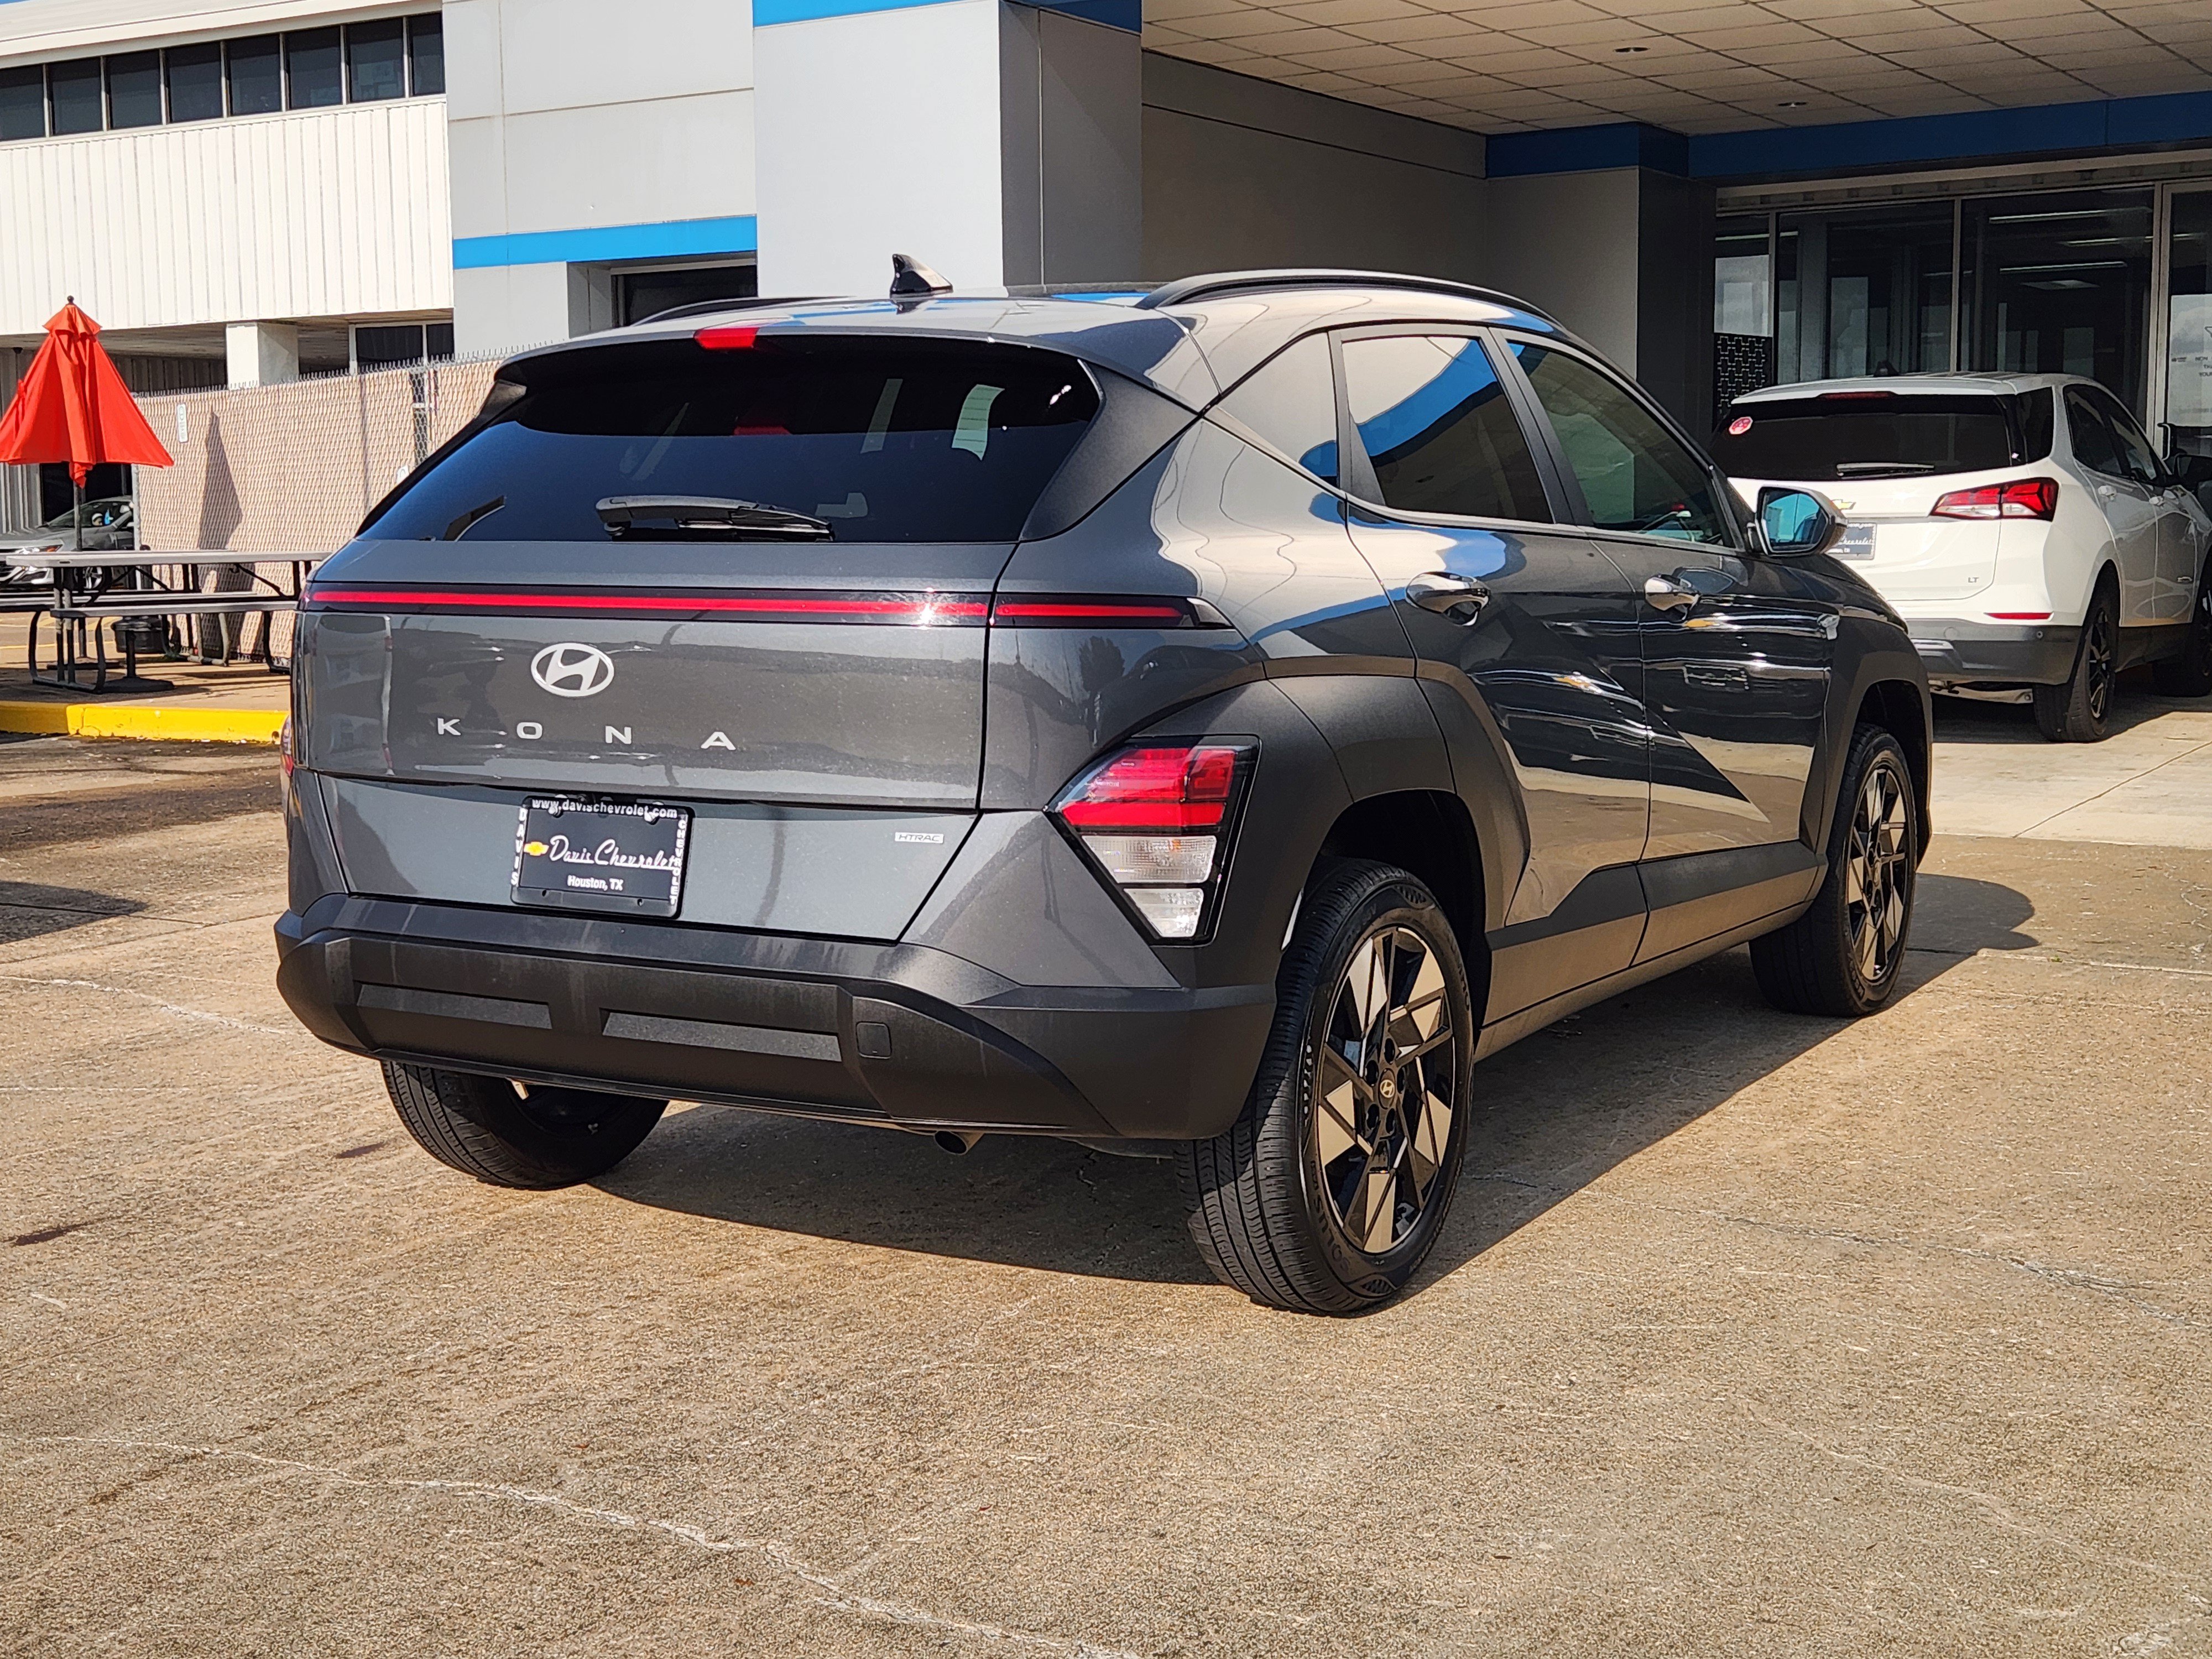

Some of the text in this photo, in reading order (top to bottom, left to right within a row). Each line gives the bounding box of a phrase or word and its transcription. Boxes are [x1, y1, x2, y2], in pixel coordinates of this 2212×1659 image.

[437, 718, 736, 750] KONA
[532, 799, 677, 818] www.davischevrolet.com
[511, 808, 528, 886] DAVIS
[549, 835, 677, 870] Davis Chevrolet
[670, 820, 686, 905] CHEVROLET
[567, 875, 624, 891] Houston, TX
